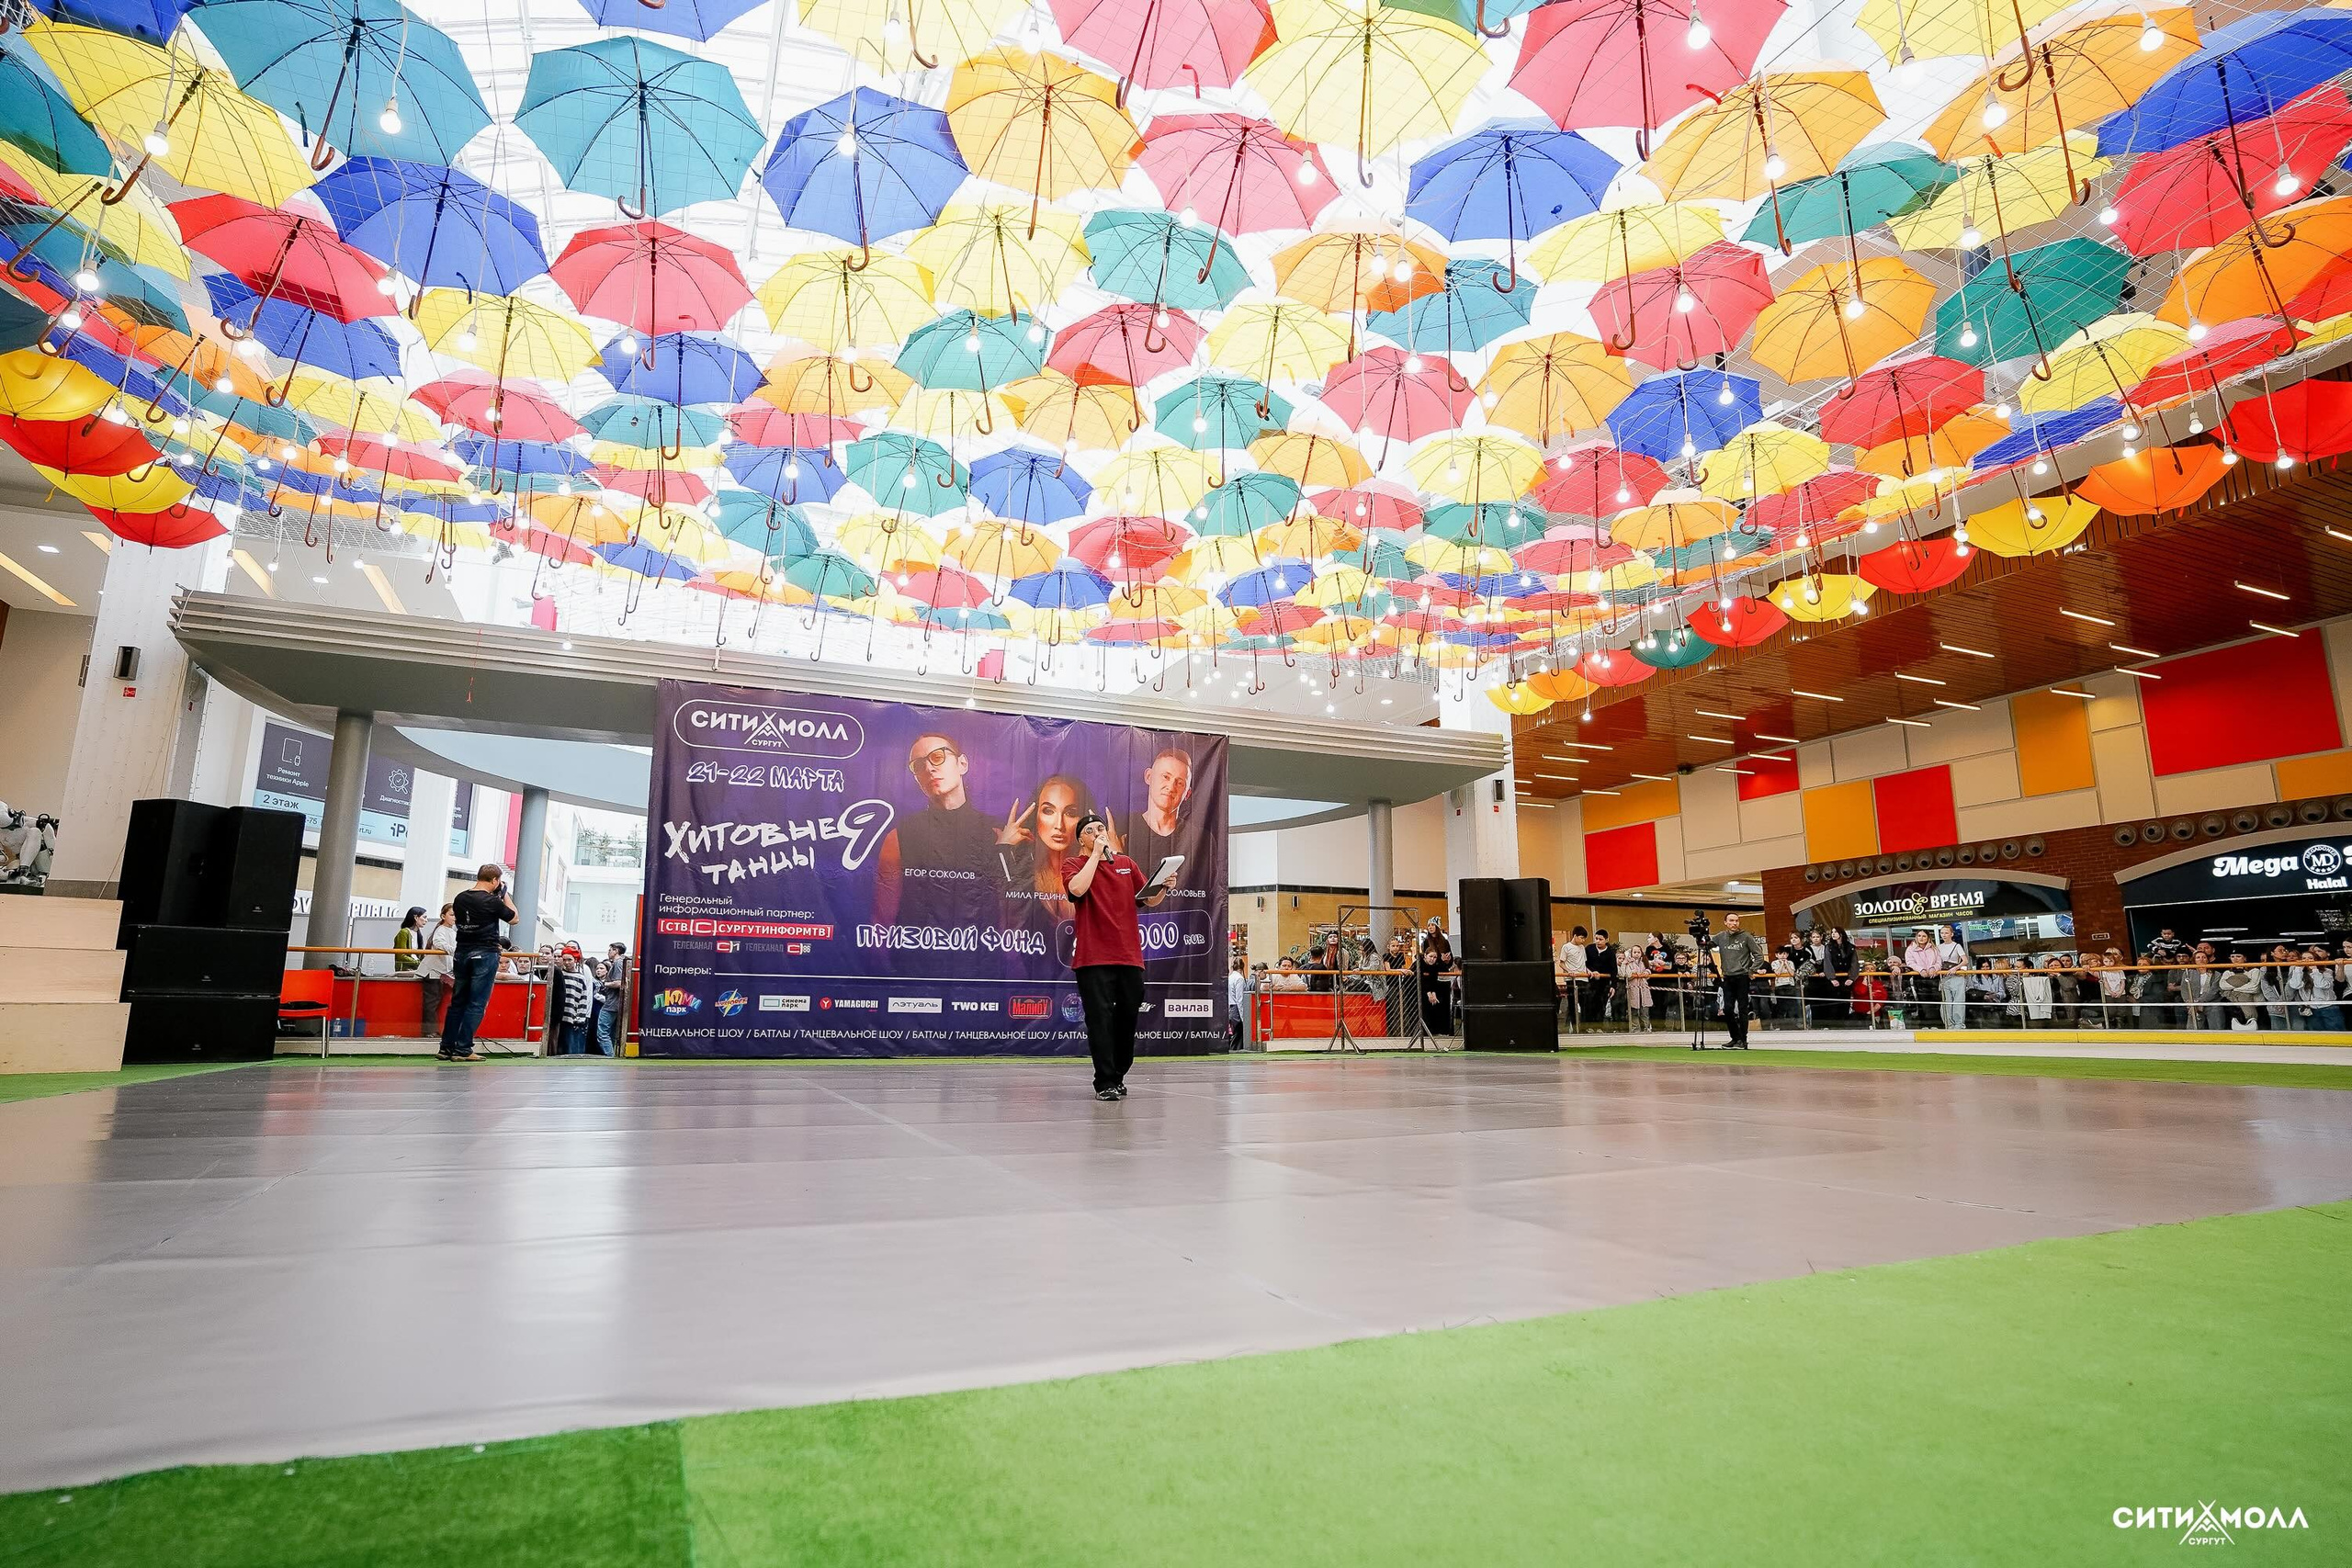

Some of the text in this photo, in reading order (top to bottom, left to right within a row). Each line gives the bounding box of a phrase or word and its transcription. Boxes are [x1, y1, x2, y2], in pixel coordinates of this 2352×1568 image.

[691, 710, 849, 740] СИТИ МОЛЛ
[752, 739, 782, 748] СУРГУТ
[277, 767, 300, 777] Ремонт
[686, 761, 844, 793] 21-22 МАРТА
[266, 773, 310, 787] техники Apple
[263, 795, 299, 809] 2 этаж
[2311, 853, 2335, 867] MD
[701, 847, 815, 886] ТАНЦЫ
[2212, 856, 2299, 877] Mega
[905, 868, 975, 879] ЕГОР СОКОЛОВ
[2306, 876, 2348, 890] Halal
[1005, 891, 1068, 900] МИЛА РЕДИНА
[1166, 889, 1205, 897] СОЛОВЬЕВ
[660, 893, 732, 906] Генеральный
[1930, 891, 1984, 908] ВРЕМЯ
[659, 904, 815, 919] информационный партнер:
[1869, 914, 1927, 924] СПЕЦИАЛИЗИРОВАННЫЙ
[856, 923, 978, 951] ПРИЗОВОЙ
[980, 926, 1046, 954] ФОНД
[1183, 934, 1204, 945] RUB
[673, 941, 713, 951] ТЕЛЕКАНАЛ
[745, 942, 784, 953] ТЕЛЕКАНАЛ
[655, 964, 712, 976] Партнеры:
[666, 1006, 686, 1014] парк
[835, 999, 879, 1009] YAMAGUCHI
[952, 1001, 999, 1011] TWO KEI
[1168, 1003, 1210, 1012] ванлав
[718, 1029, 743, 1038] ШОУ
[753, 1029, 791, 1039] БАТТЛЫ
[800, 1029, 876, 1040] ТАНЦЕВАЛЬНОЕ
[878, 1030, 903, 1039] ШОУ
[912, 1030, 946, 1040] БАТТЛЫ
[956, 1031, 1027, 1041] ТАНЦЕВАЛЬНОЕ
[1028, 1031, 1050, 1040] ШОУ
[1163, 1031, 1183, 1039] ШОУ
[1191, 1031, 1220, 1039] БАТТЛЫ
